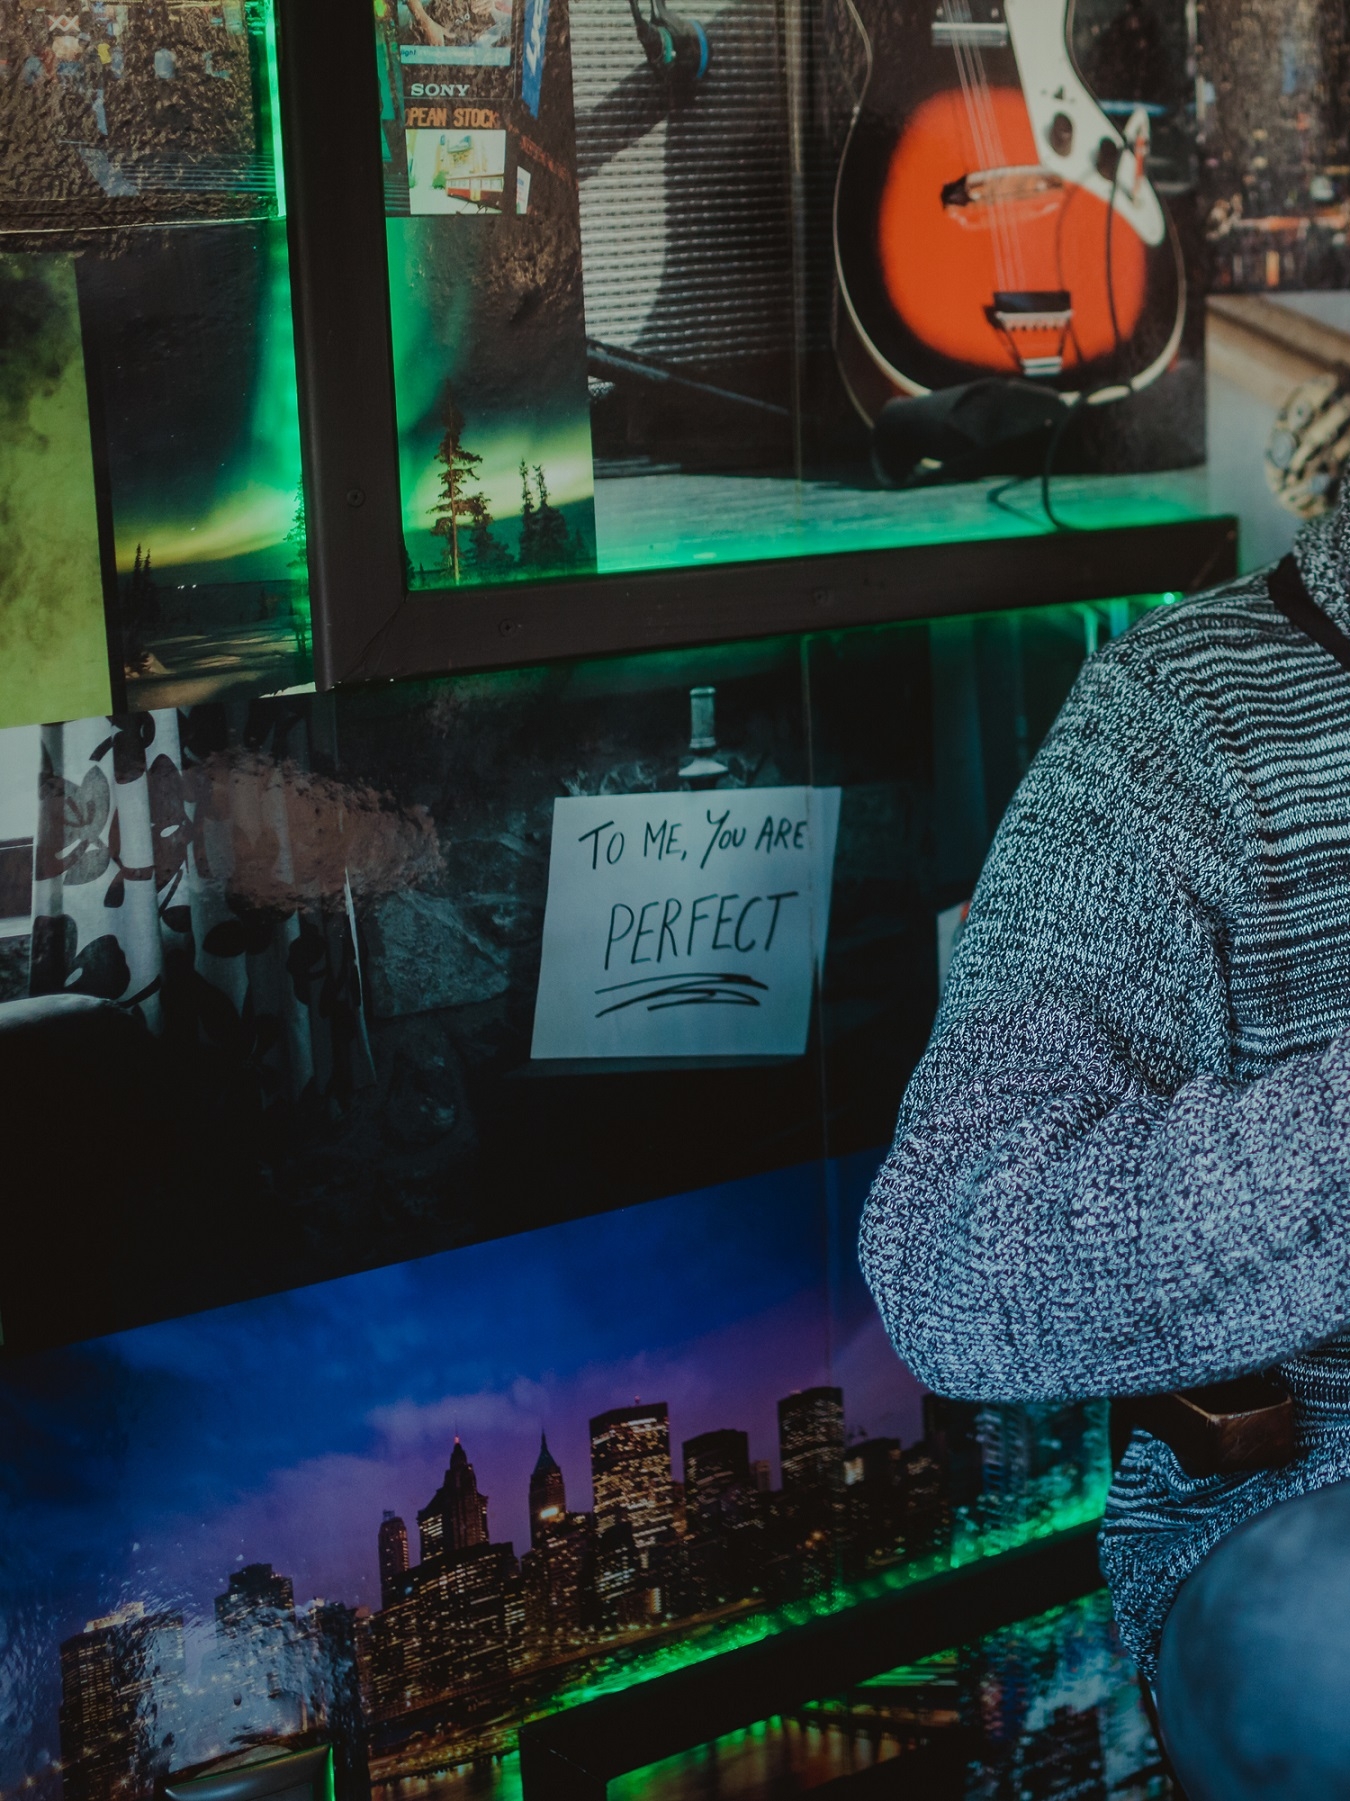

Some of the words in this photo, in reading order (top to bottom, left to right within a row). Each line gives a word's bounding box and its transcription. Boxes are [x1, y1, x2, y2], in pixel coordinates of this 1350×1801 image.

[410, 83, 470, 97] SONY
[578, 820, 625, 870] TO
[643, 819, 688, 861] ME,
[754, 815, 808, 854] ARE
[603, 891, 800, 971] PERFECT
